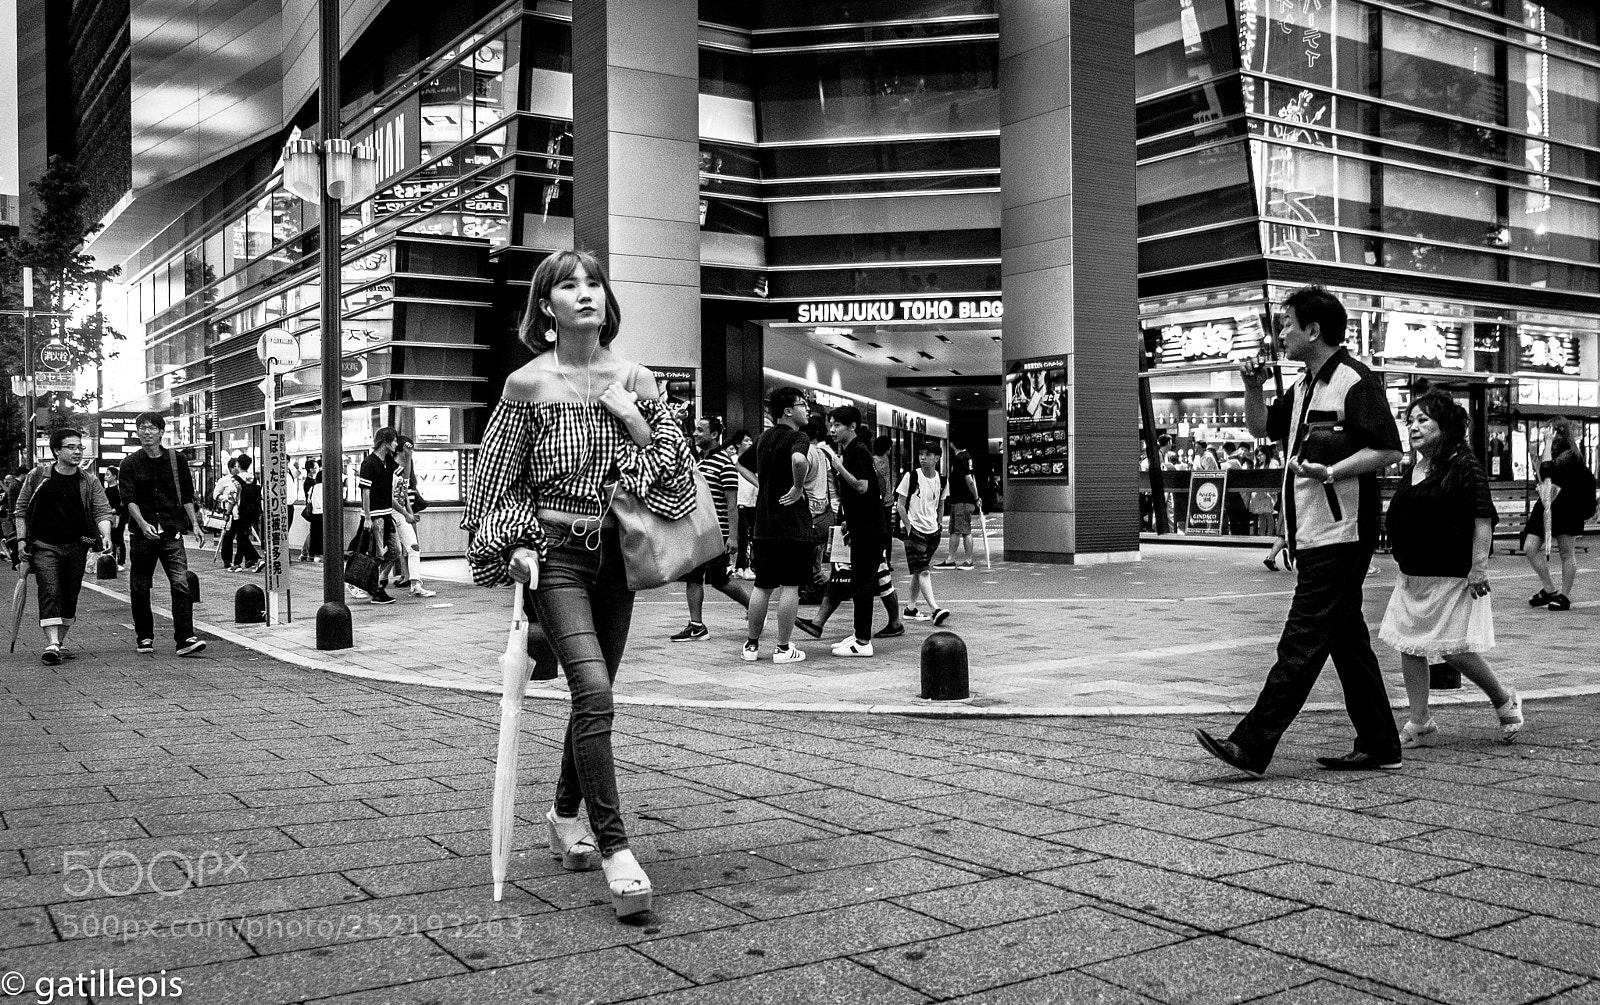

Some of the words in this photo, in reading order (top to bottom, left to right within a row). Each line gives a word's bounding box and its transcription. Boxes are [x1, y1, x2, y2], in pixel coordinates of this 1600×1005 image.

[798, 302, 894, 323] SHINJUKU
[900, 301, 953, 320] TOHO
[959, 301, 1003, 319] BLDG
